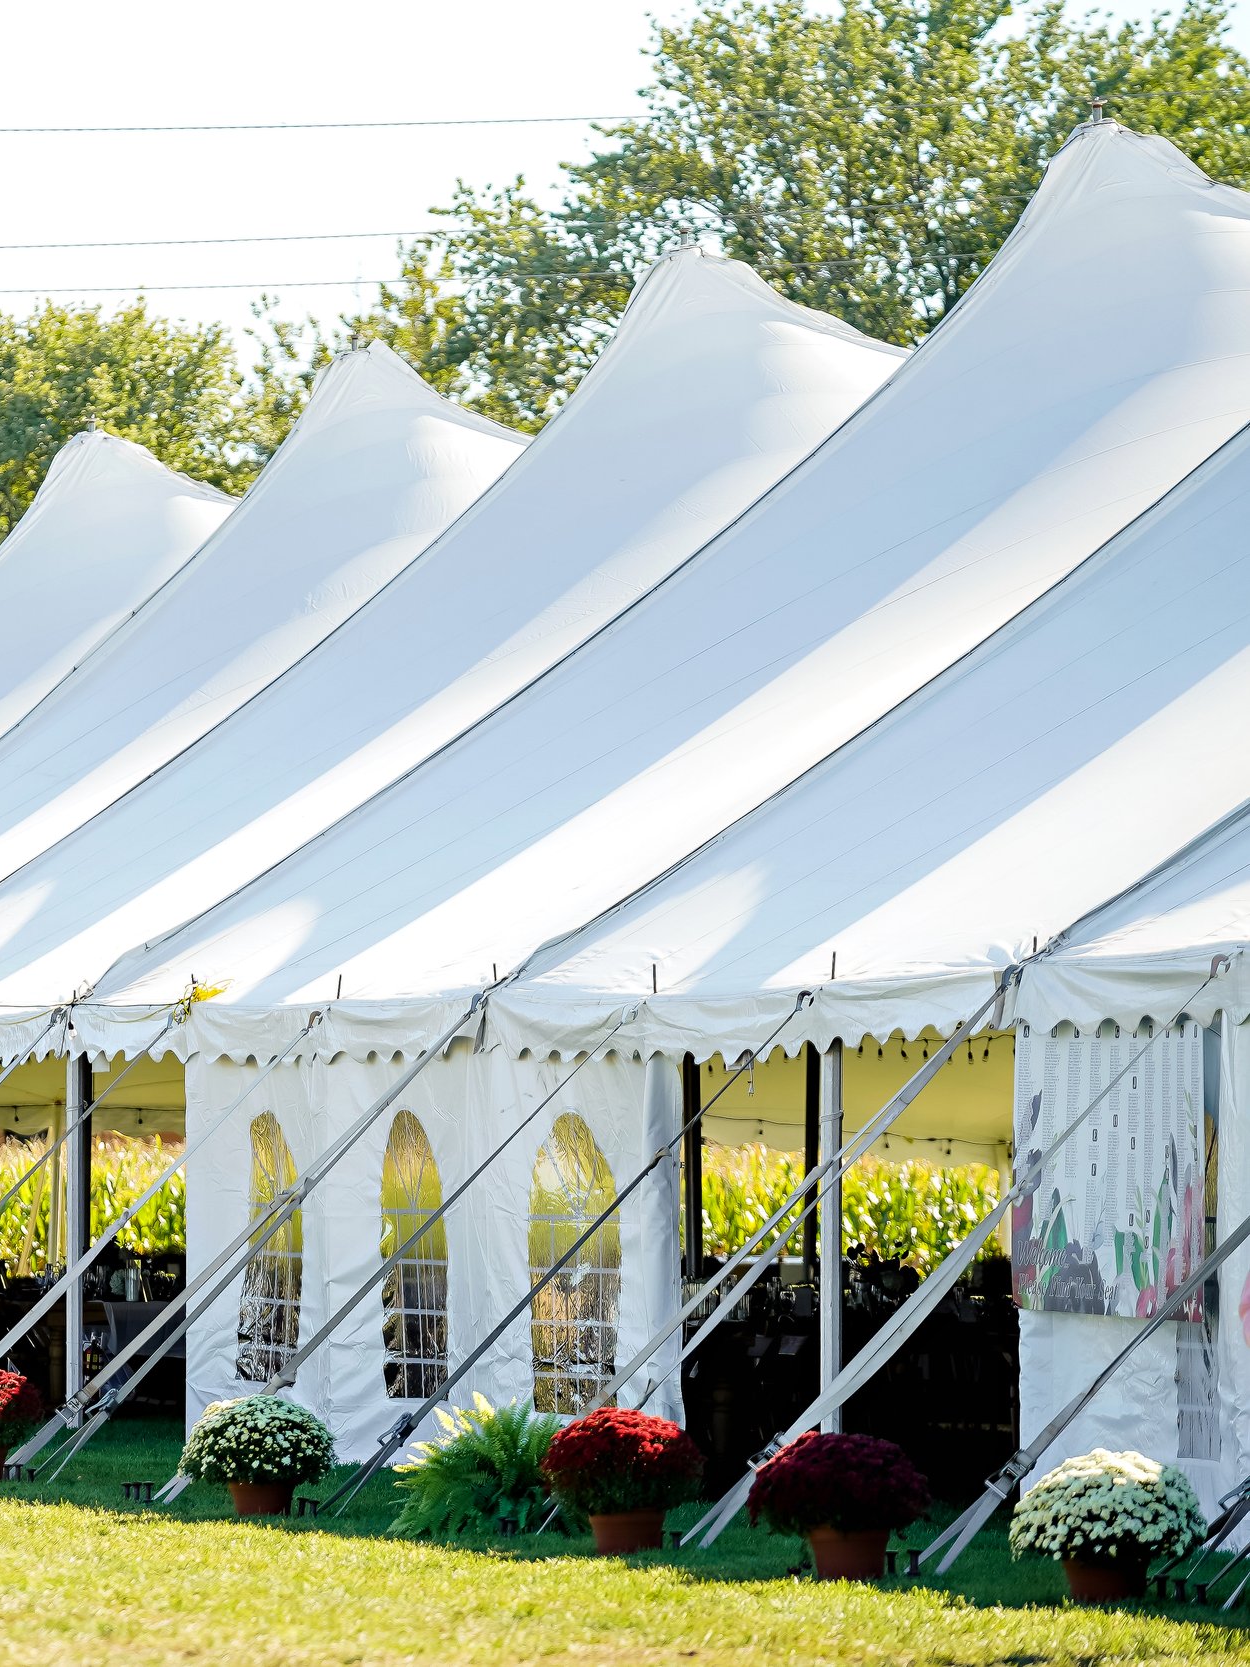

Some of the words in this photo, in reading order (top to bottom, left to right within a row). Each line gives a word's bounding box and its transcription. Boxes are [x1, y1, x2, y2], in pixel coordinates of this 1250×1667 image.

[1018, 1273, 1046, 1296] Please
[1049, 1275, 1073, 1298] Find
[1075, 1276, 1097, 1300] Your
[1098, 1278, 1119, 1301] Seat
